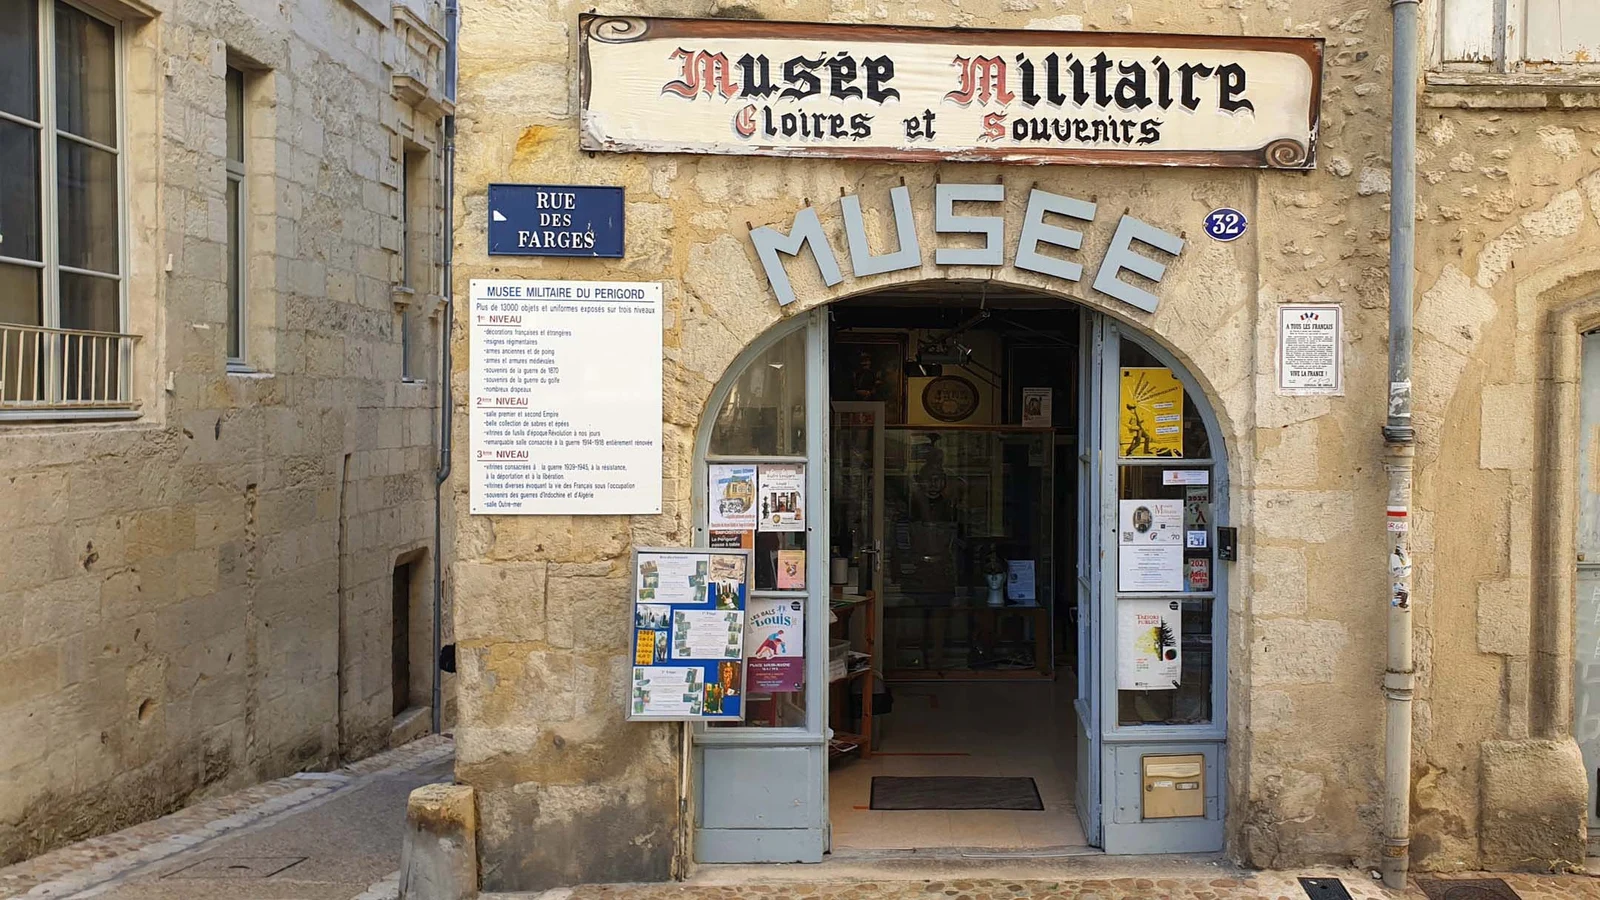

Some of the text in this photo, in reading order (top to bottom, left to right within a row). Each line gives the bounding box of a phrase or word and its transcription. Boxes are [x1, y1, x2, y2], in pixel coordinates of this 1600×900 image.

[661, 46, 1255, 114] Musée Militaire
[903, 109, 937, 141] et
[977, 112, 1162, 145] Souvenirs
[536, 192, 576, 210] RUE
[539, 213, 572, 228] DES
[1211, 213, 1239, 235] 32
[517, 230, 595, 250] FARGES
[749, 183, 1185, 313] MUSEE
[487, 286, 644, 299] MUSEE MILITAIRE DU PERIGORD
[476, 302, 488, 311] Plus
[491, 302, 498, 311] de
[501, 303, 518, 311] 13000
[521, 303, 539, 312] objets
[542, 303, 548, 312] et
[550, 304, 578, 312] uniformes
[619, 304, 631, 313] trois
[634, 305, 655, 314] niveaux
[490, 315, 521, 323] NIVEAU
[754, 613, 792, 628] Louis
